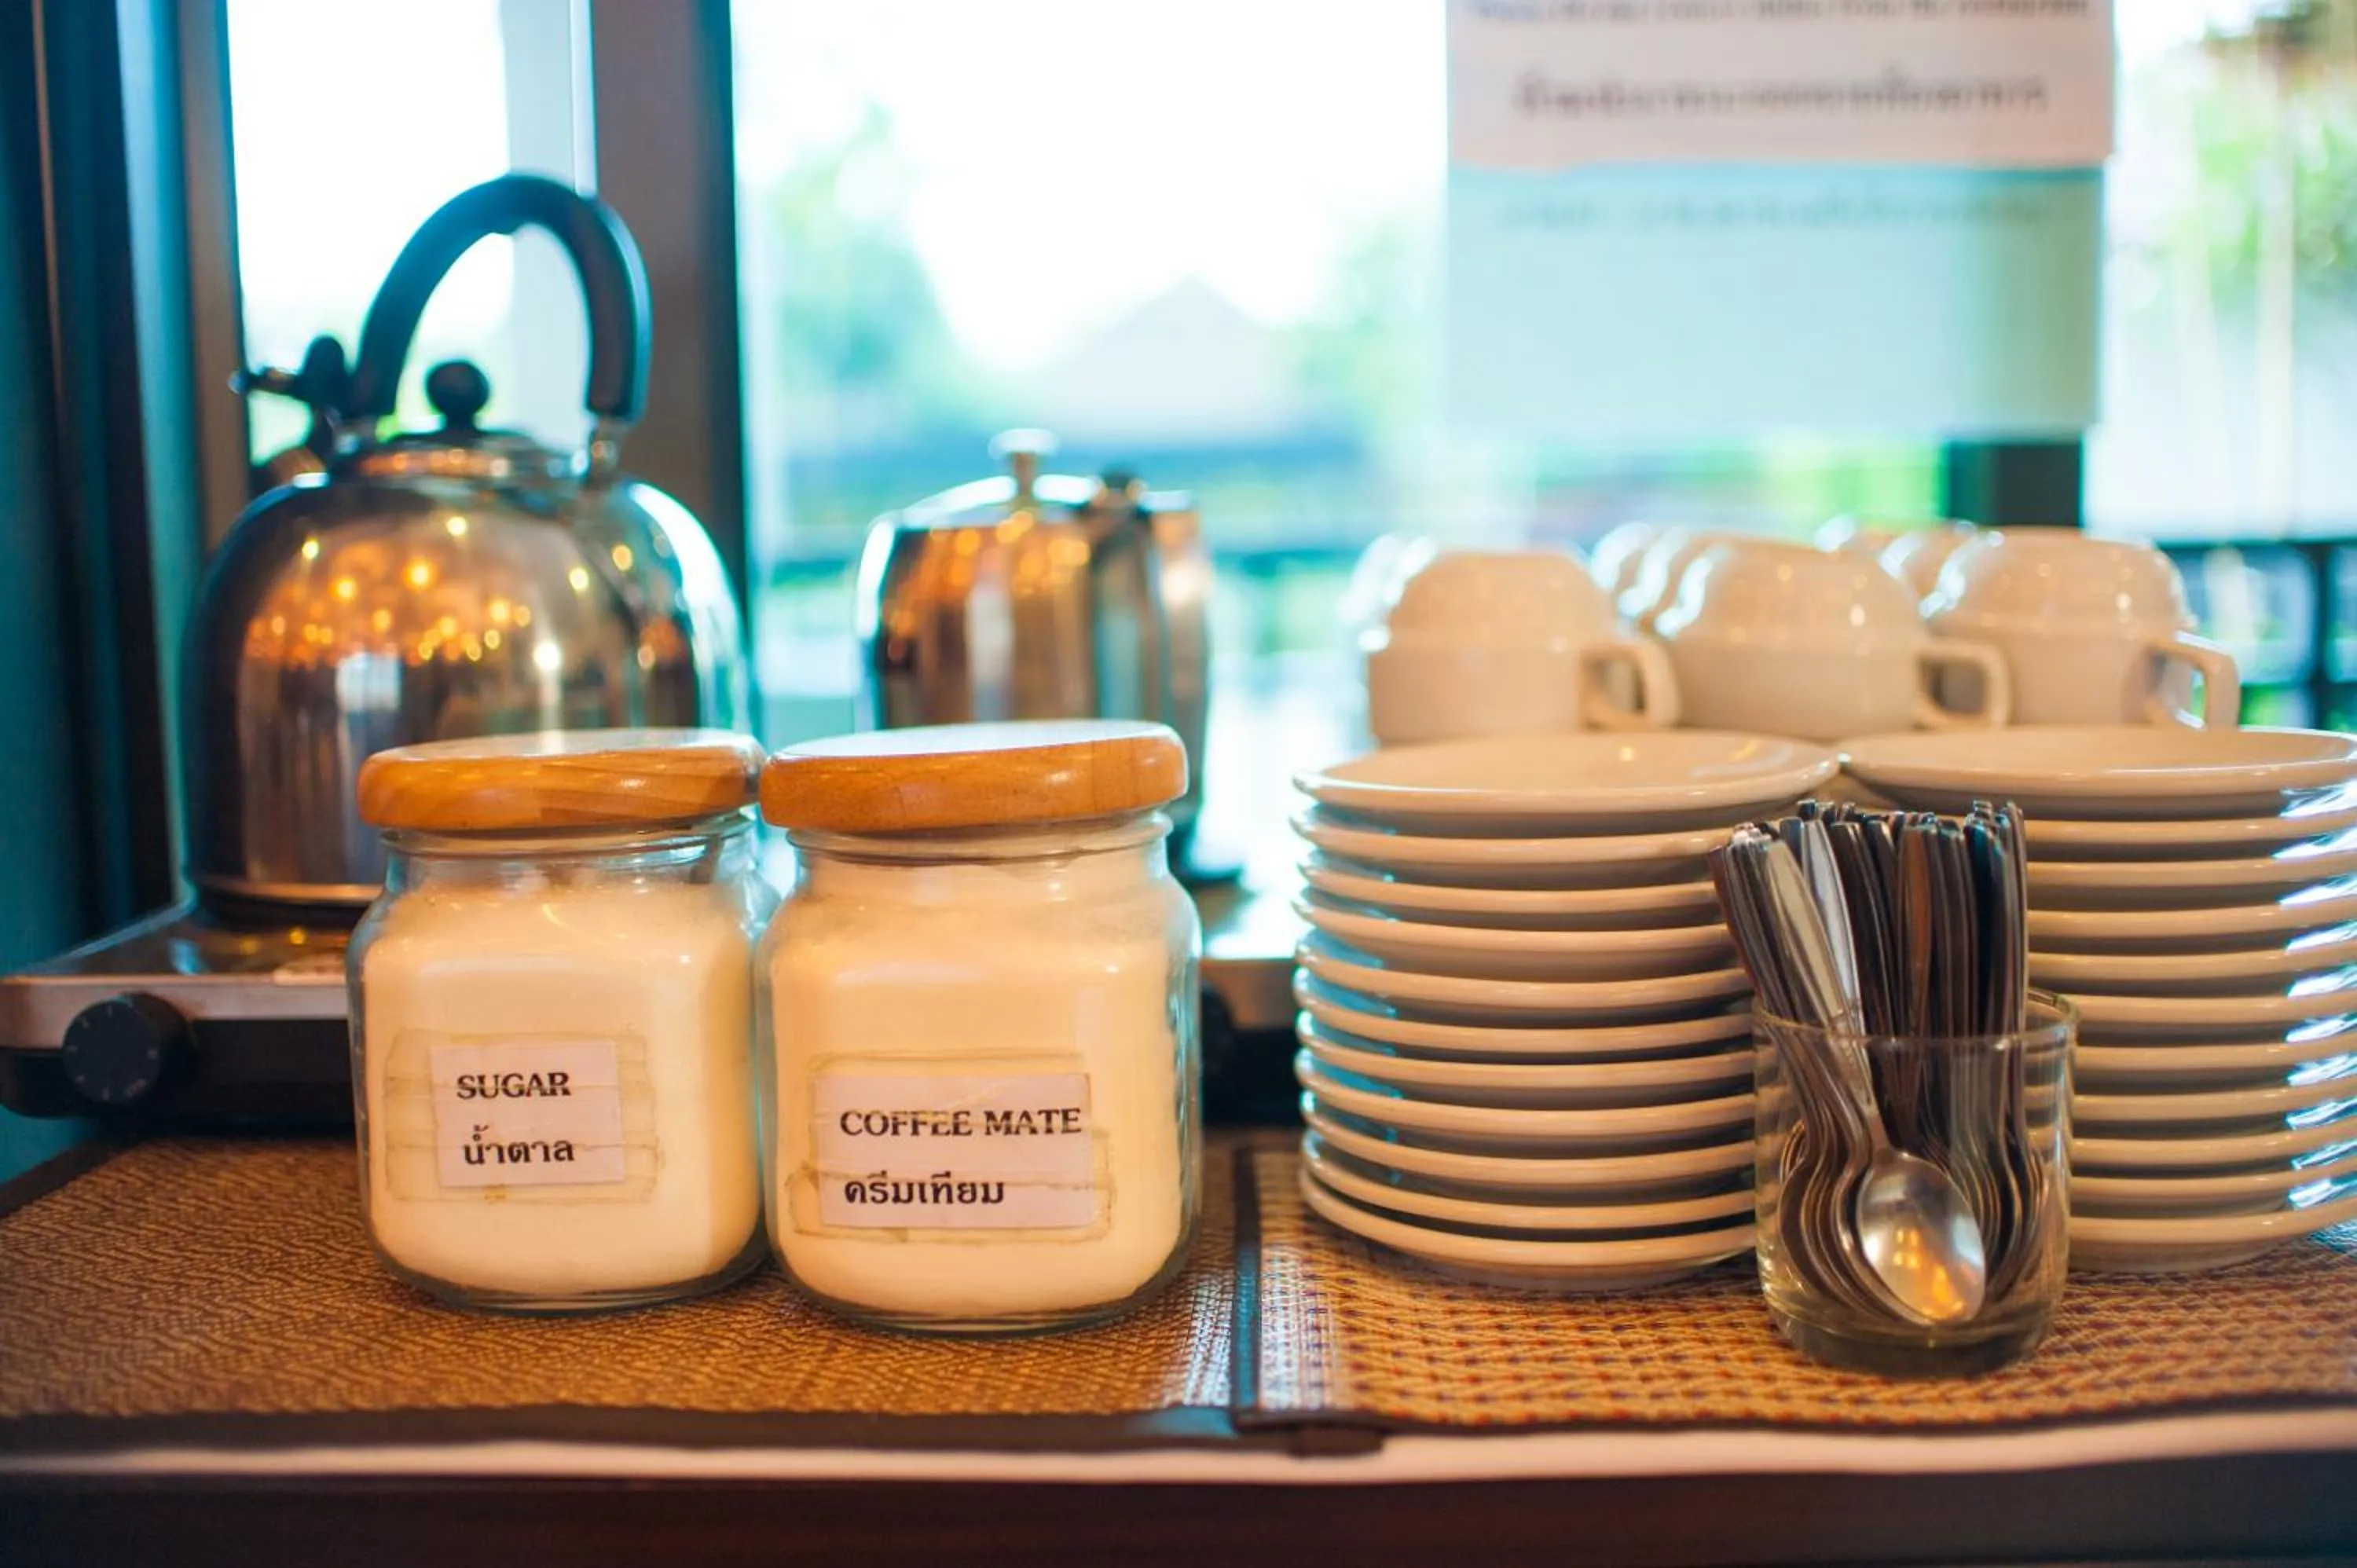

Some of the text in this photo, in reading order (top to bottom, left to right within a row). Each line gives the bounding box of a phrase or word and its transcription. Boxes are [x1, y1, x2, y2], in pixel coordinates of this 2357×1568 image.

[456, 1072, 572, 1100] SUGAR
[840, 1108, 1082, 1136] COFFEE MATE
[463, 1124, 575, 1165] น้ำตาล
[844, 1170, 1005, 1204] ครีมเทียม
